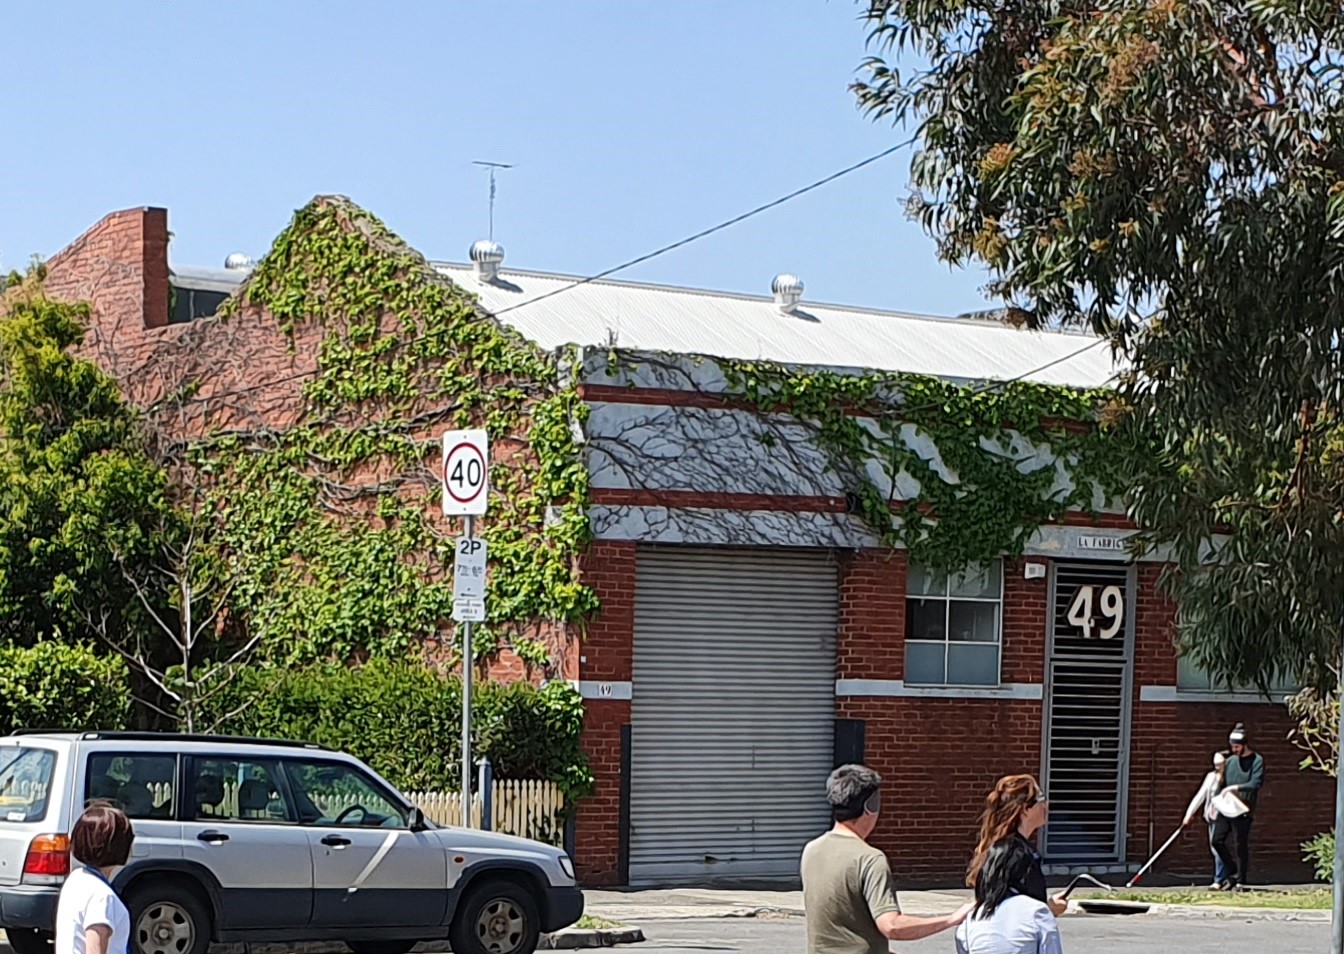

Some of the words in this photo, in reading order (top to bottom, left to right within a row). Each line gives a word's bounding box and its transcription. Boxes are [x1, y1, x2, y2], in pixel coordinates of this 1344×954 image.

[450, 458, 481, 488] 40
[460, 540, 482, 555] 2P
[1067, 585, 1123, 639] 49
